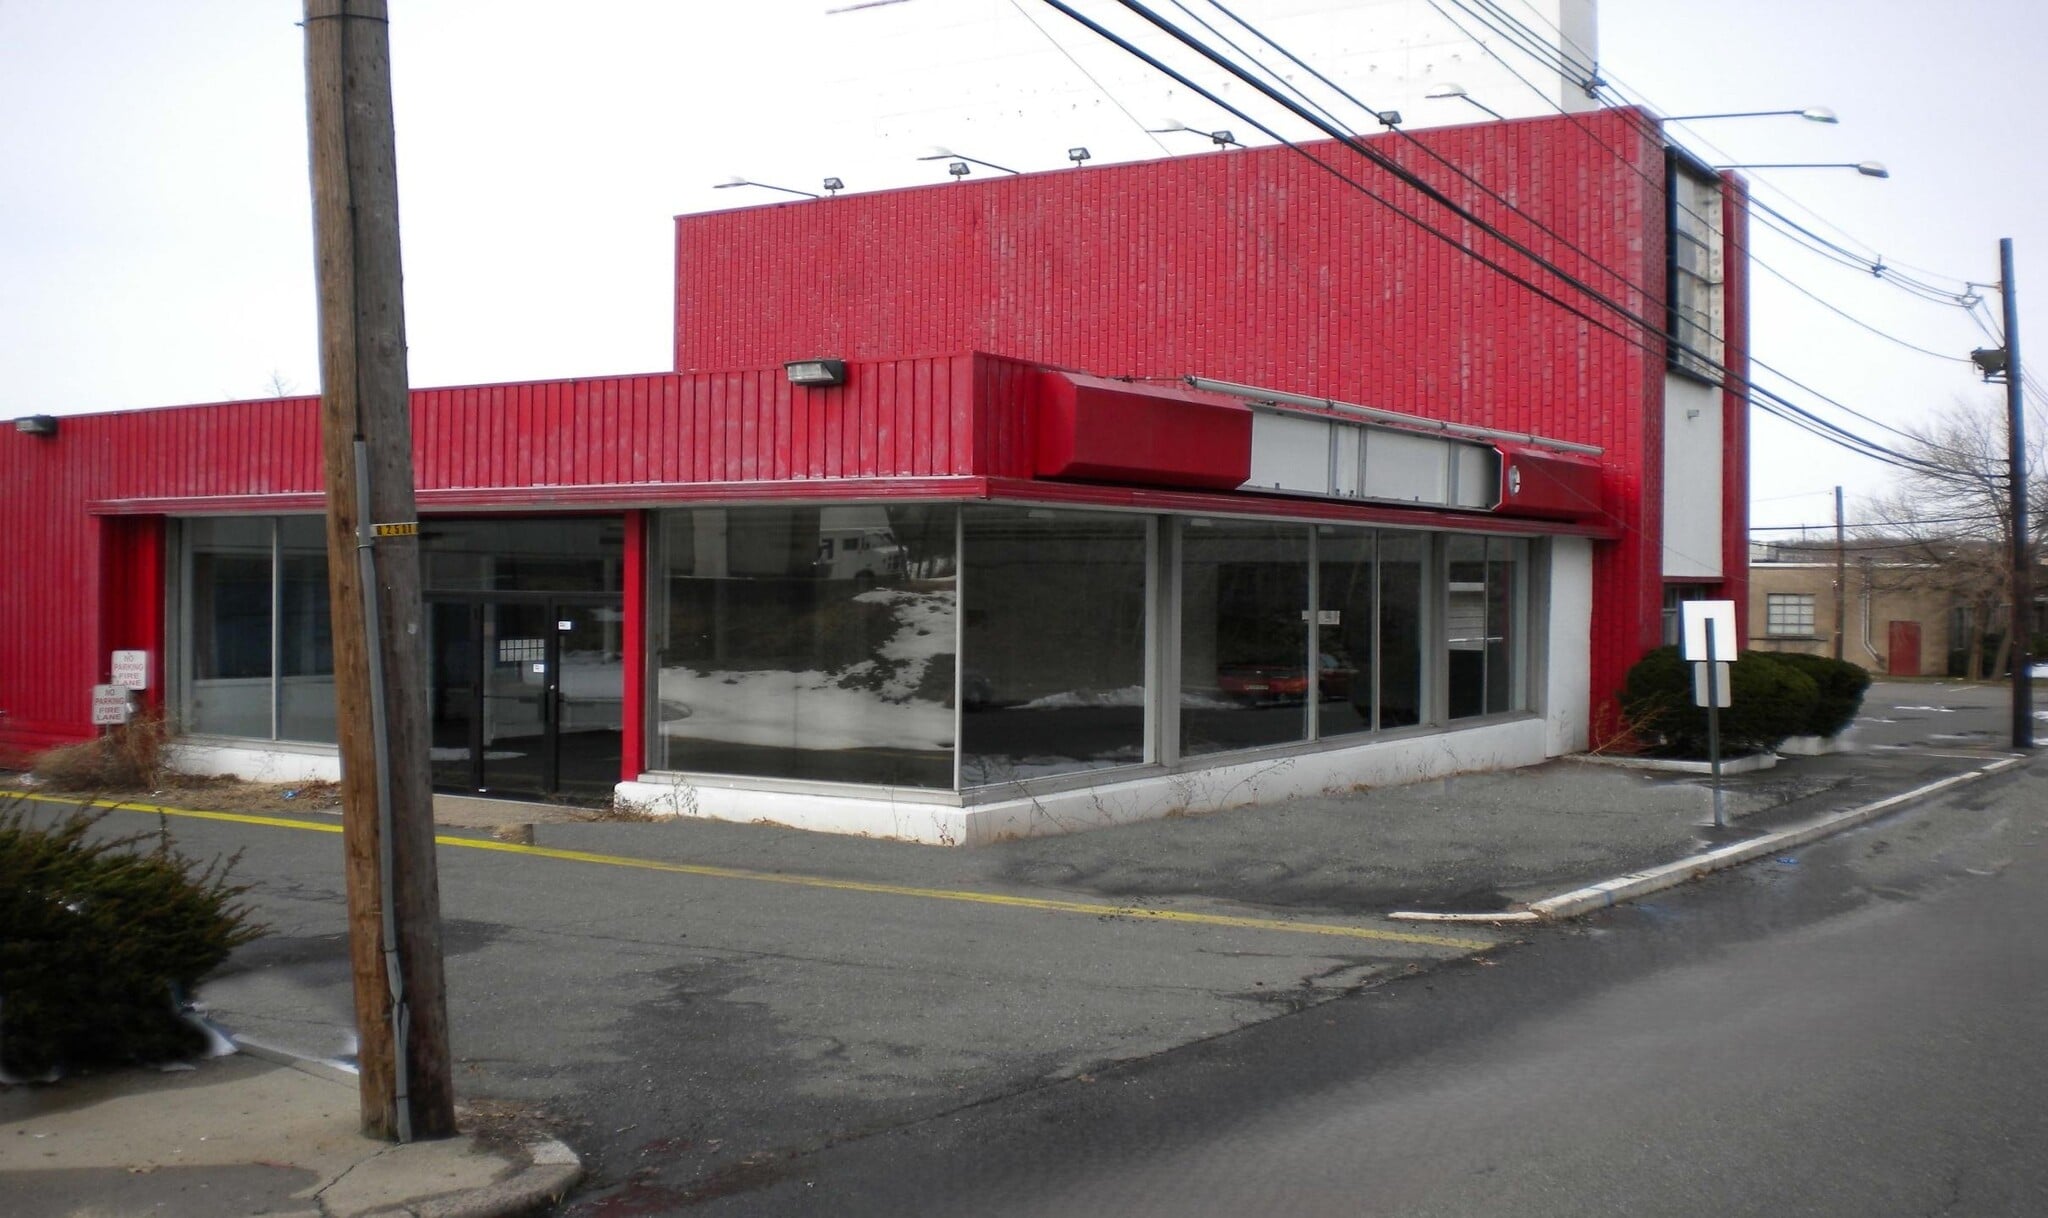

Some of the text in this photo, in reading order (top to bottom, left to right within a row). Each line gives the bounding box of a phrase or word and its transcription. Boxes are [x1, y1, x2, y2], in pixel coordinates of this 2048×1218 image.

[114, 663, 144, 671] PARKING
[105, 688, 115, 696] NO
[95, 697, 125, 705] PARKING
[99, 706, 120, 714] FIRE
